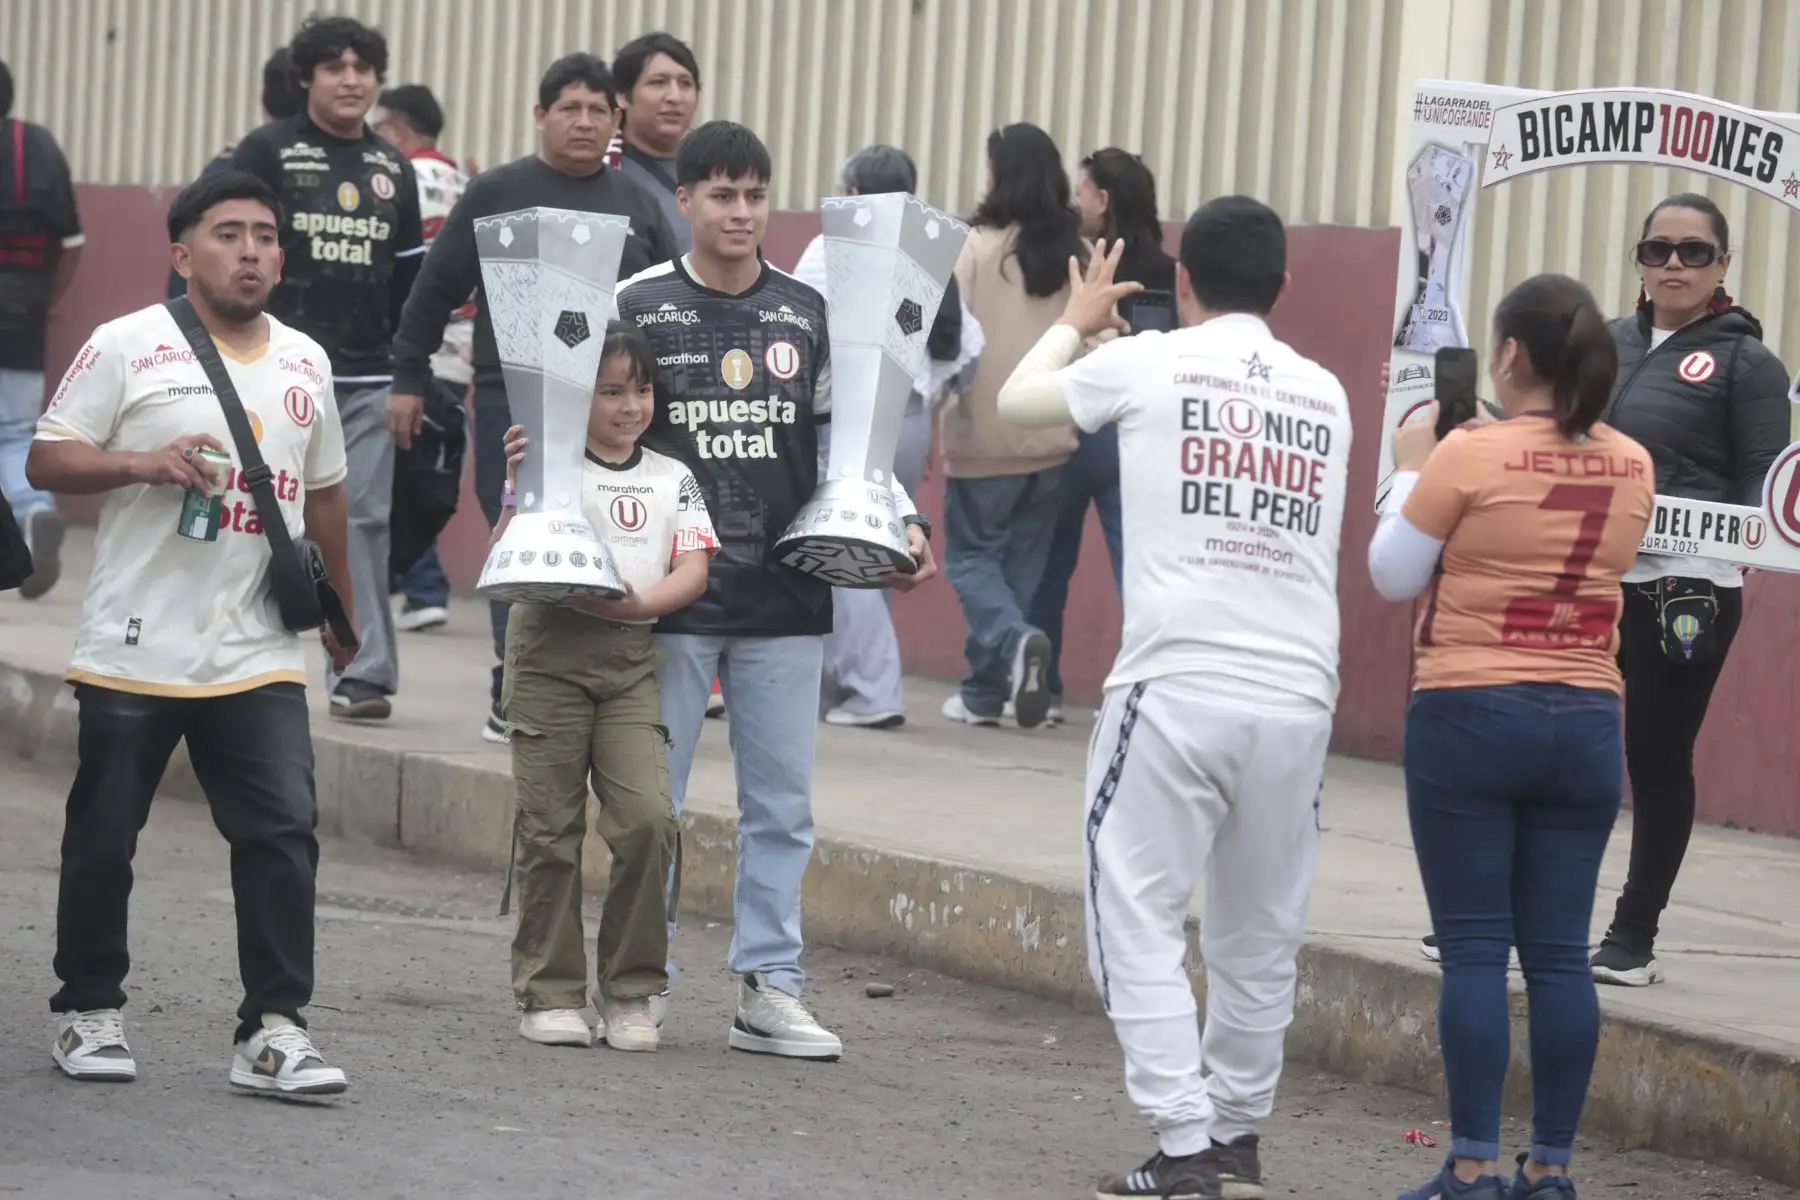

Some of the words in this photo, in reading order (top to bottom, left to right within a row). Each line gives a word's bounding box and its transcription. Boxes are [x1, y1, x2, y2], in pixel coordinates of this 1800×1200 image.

[1416, 93, 1492, 111] #LAGARRADEL
[1517, 102, 1783, 184] BICAMP100NES
[1785, 179, 1798, 196] 28
[292, 212, 391, 241] apuesta
[311, 237, 373, 266] total
[636, 312, 657, 328] SAN
[658, 310, 698, 325] CARLOS
[759, 310, 778, 323] SAN
[778, 312, 810, 330] CARLOS
[1427, 308, 1448, 322] 2023
[131, 354, 155, 374] SAN
[279, 357, 298, 373] SAN
[1174, 373, 1241, 393] CAMPEONES
[667, 395, 796, 432] apuesta
[696, 427, 778, 459] total
[1181, 436, 1327, 501] GRANDE
[1505, 451, 1646, 480] JETOUR
[597, 484, 654, 494] marathon
[1181, 480, 1240, 519] DEL
[1250, 487, 1321, 537] PERÚ
[1654, 506, 1692, 538] DEL
[1205, 537, 1294, 565] marathon
[1538, 483, 1615, 600] 7
[1672, 539, 1699, 554] 2025
